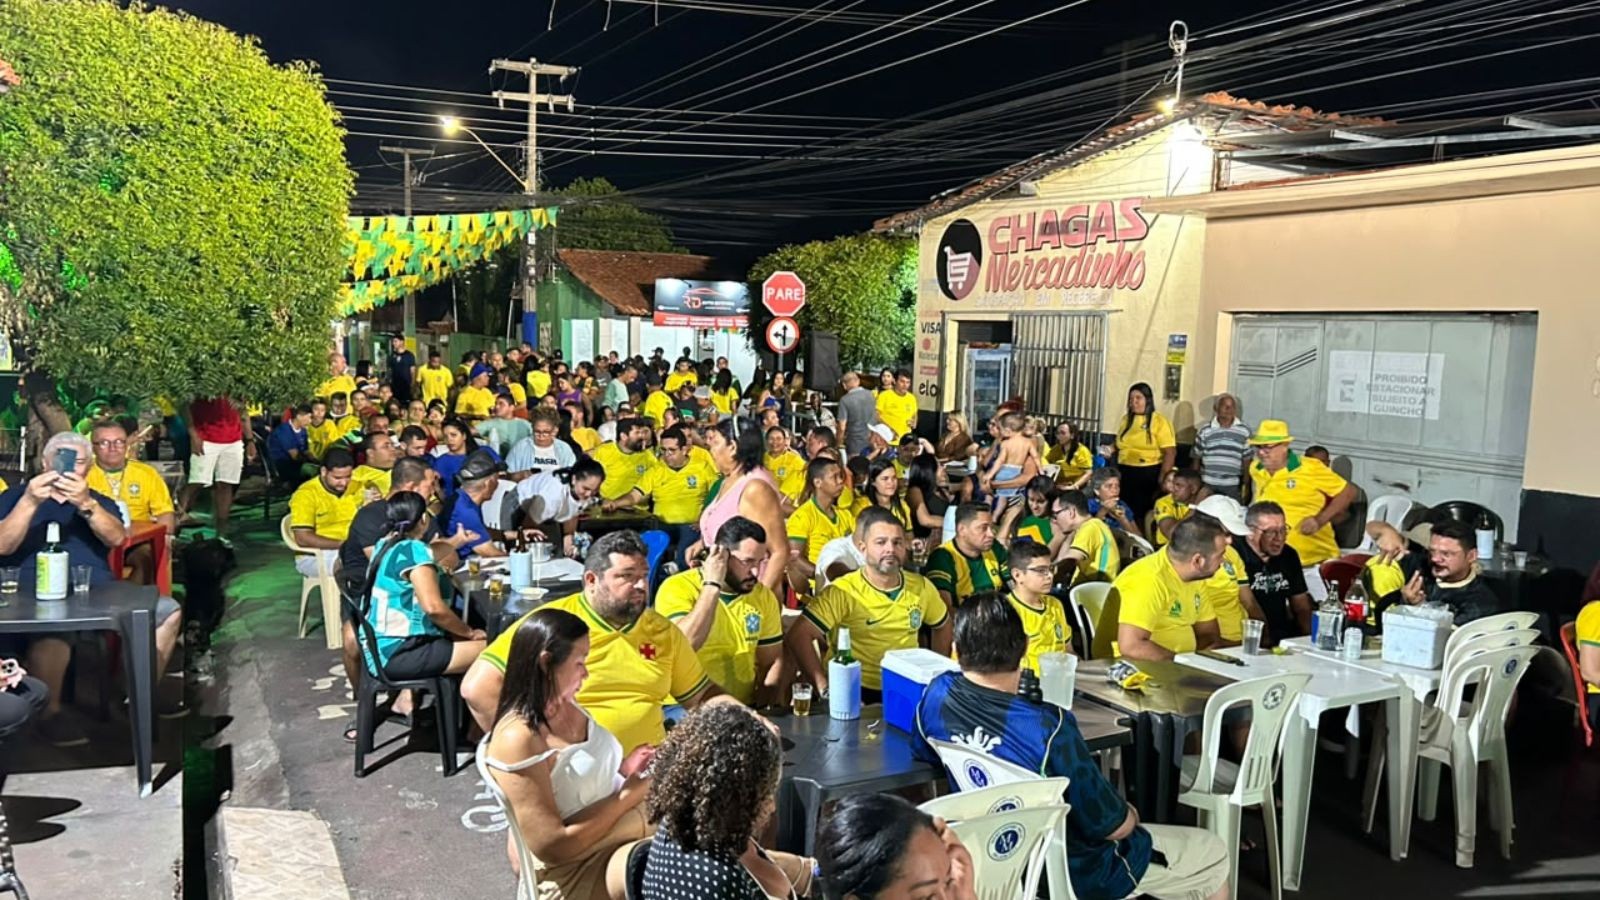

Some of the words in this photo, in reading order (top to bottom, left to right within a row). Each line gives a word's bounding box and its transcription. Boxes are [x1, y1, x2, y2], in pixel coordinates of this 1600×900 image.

[988, 196, 1149, 255] CHAGAS
[985, 240, 1146, 293] Mercadinho
[766, 287, 801, 301] PARE
[921, 322, 941, 334] VISA
[1375, 373, 1428, 385] PROIBIDO
[919, 379, 940, 397] elo
[1366, 383, 1436, 396] ESTACIONAR
[1372, 394, 1417, 405] SUJEITO
[1418, 397, 1427, 406] A
[1373, 404, 1426, 417] GUINCHO
